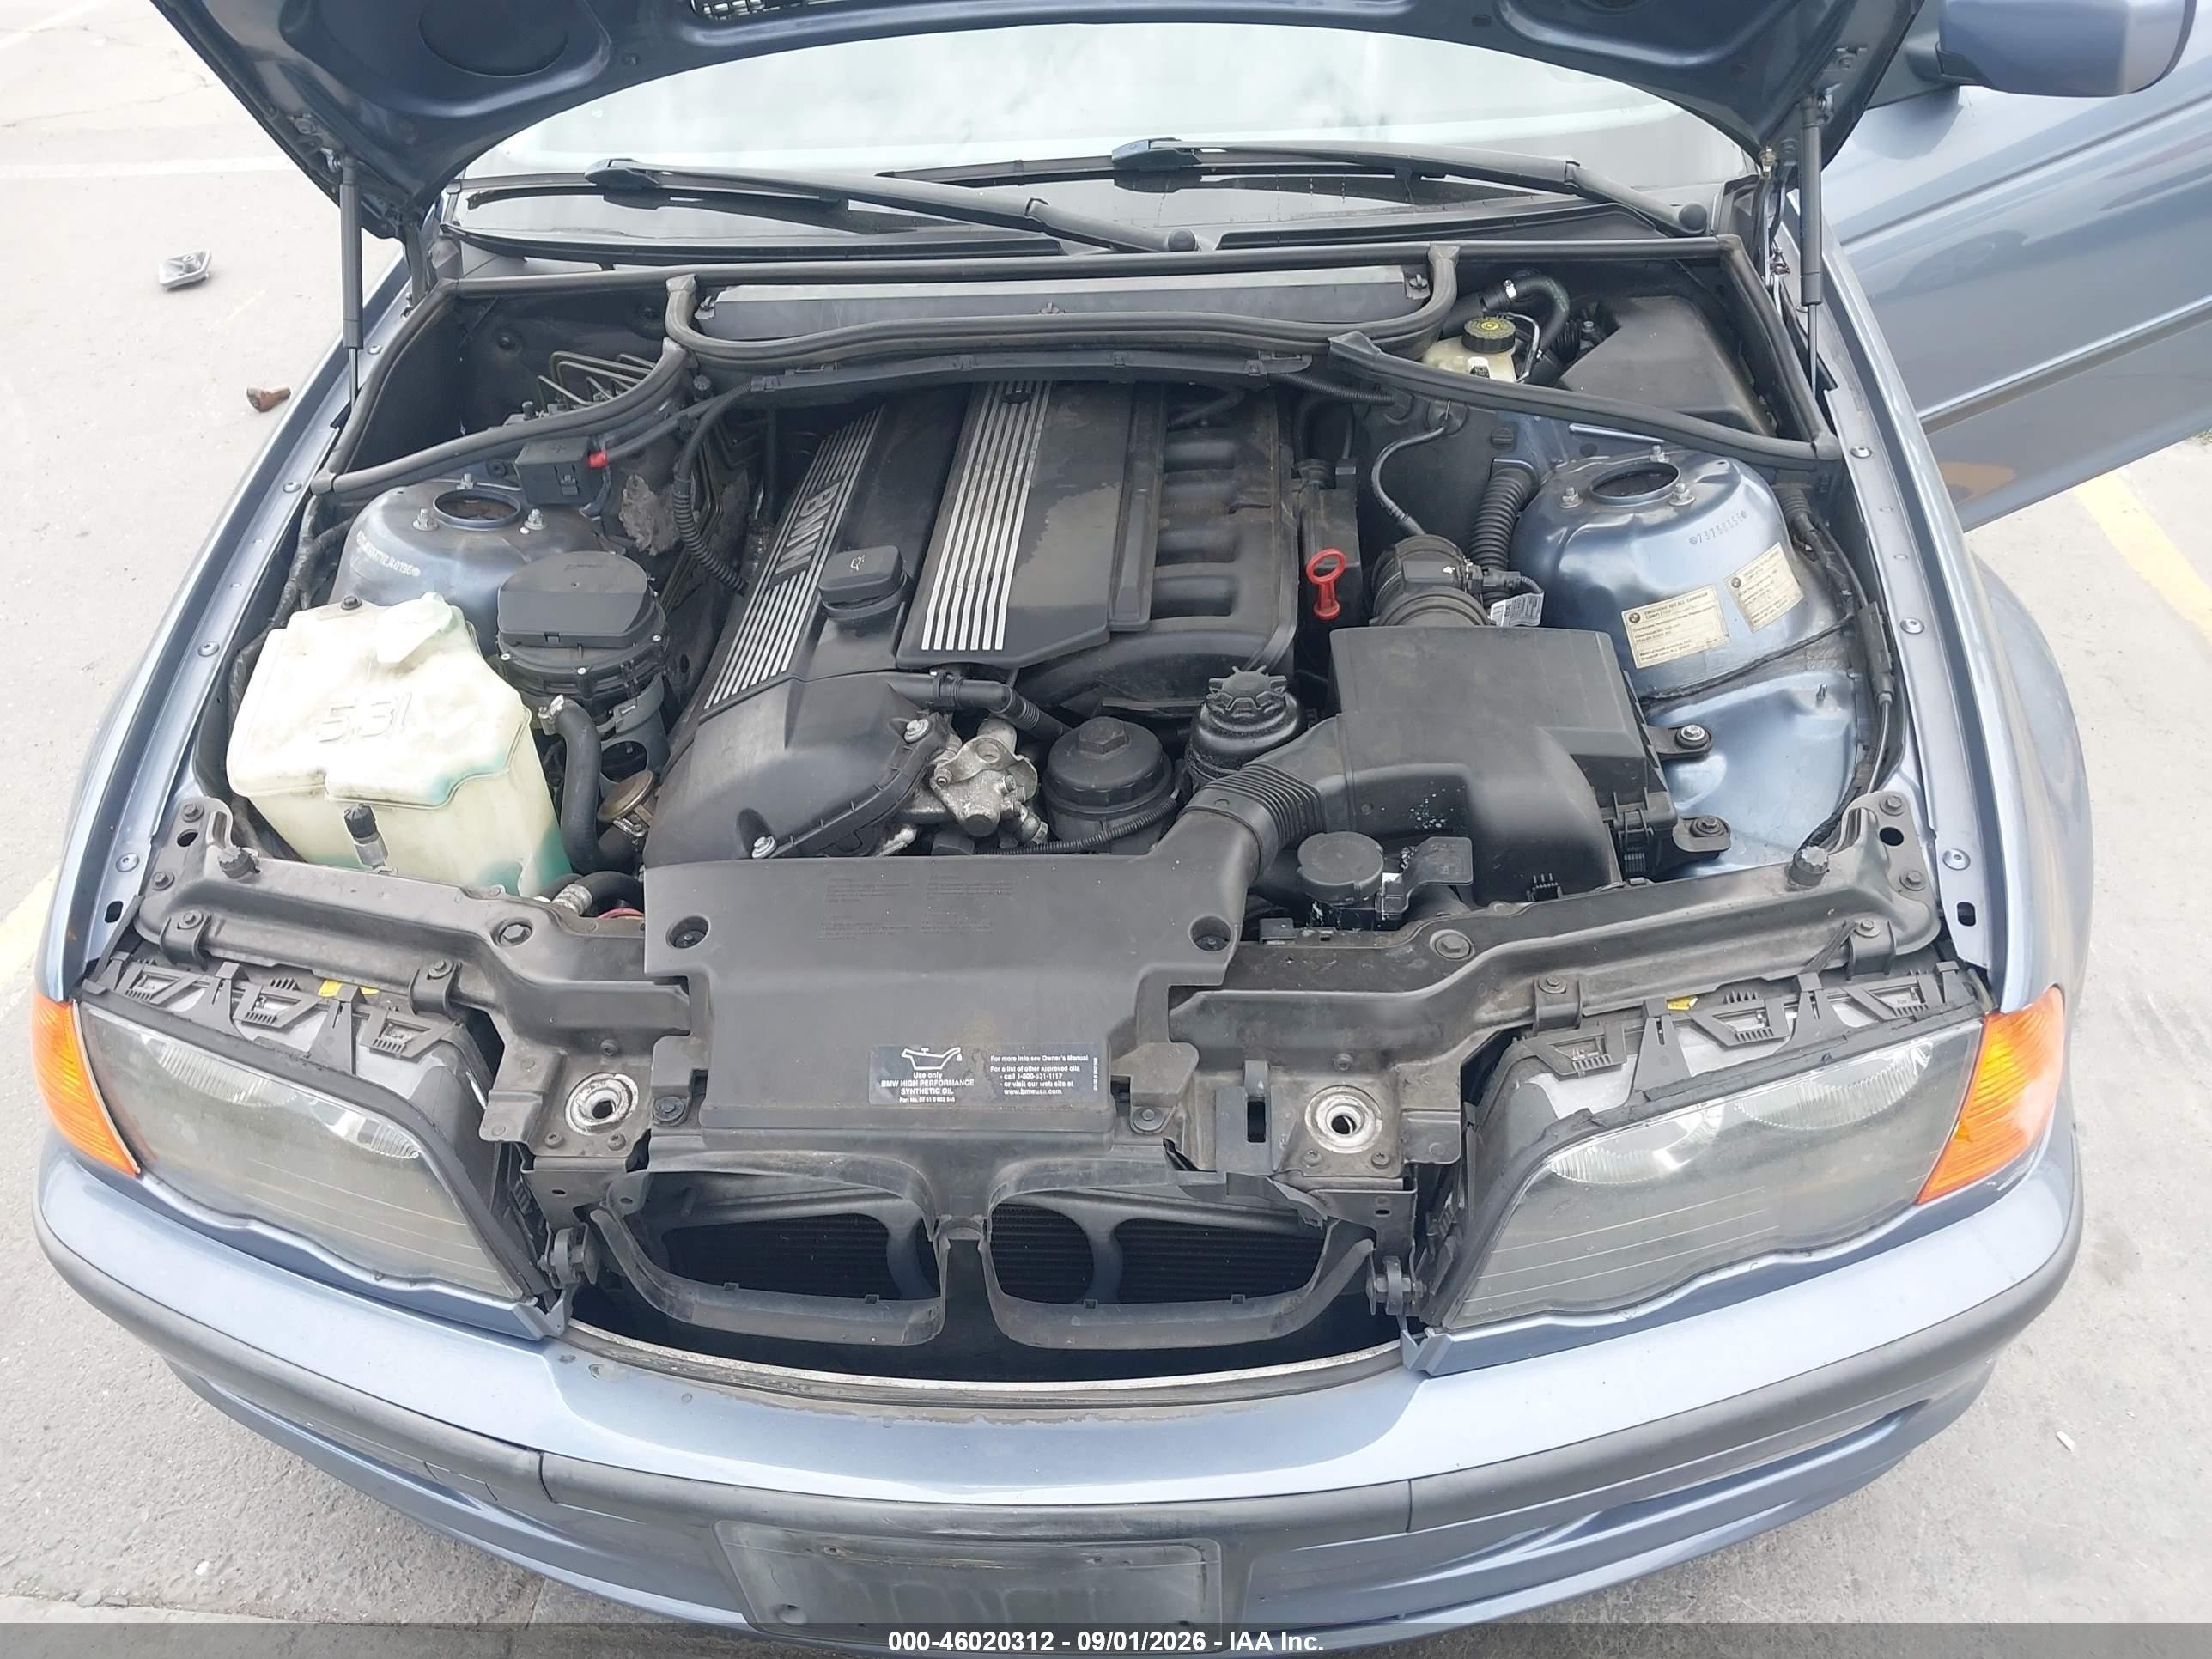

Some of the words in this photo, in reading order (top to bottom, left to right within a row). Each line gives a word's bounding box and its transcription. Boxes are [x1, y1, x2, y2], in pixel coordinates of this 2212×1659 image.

[775, 482, 841, 574] BMW
[927, 1071, 943, 1080] only
[919, 1079, 975, 1087] PERFORMANCE
